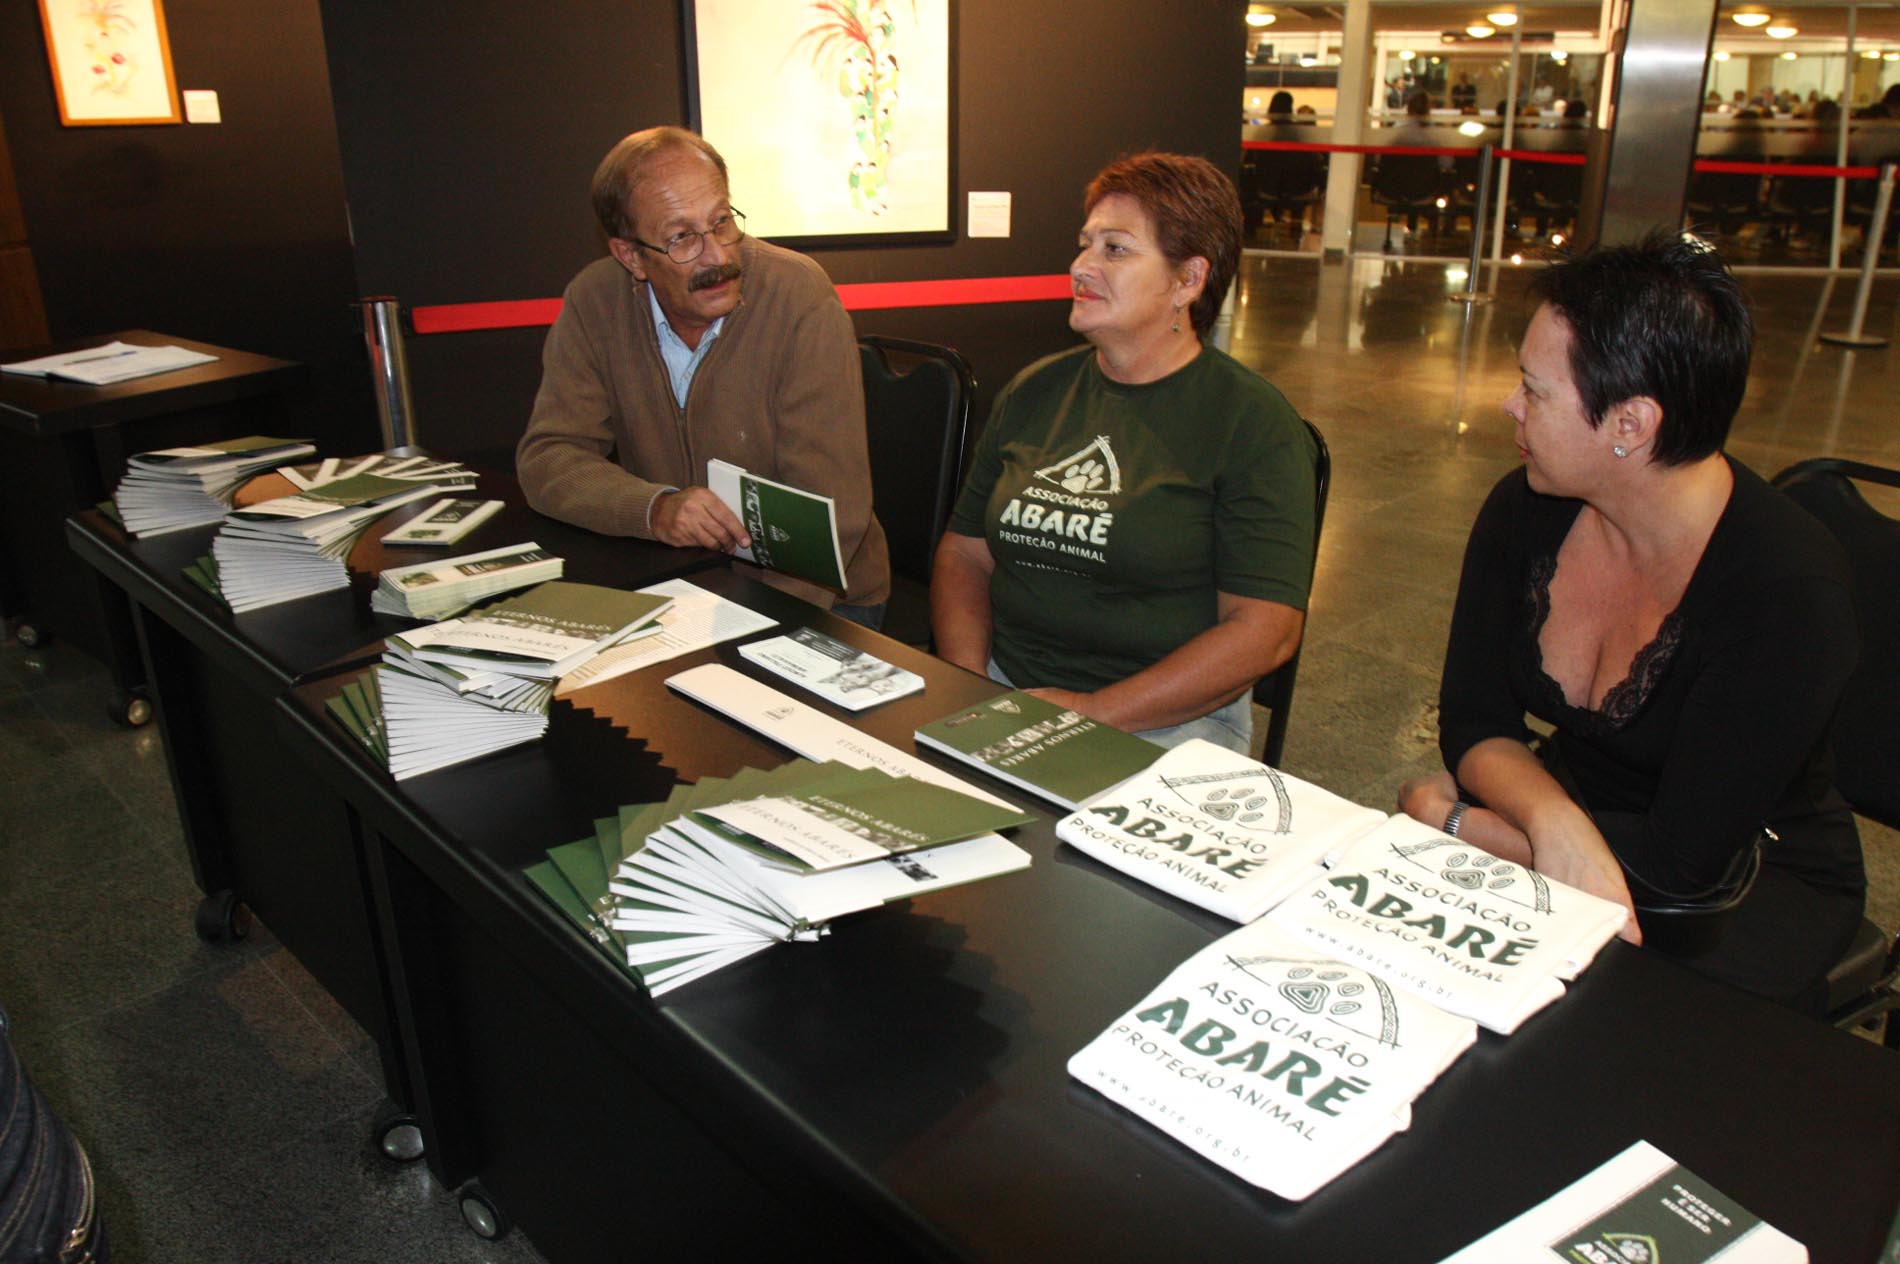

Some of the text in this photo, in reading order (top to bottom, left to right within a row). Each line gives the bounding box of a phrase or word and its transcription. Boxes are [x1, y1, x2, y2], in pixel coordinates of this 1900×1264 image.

[1000, 499, 1114, 546] ABARÉ
[1022, 486, 1109, 511] ASSOCIAÇÃO
[999, 530, 1106, 563] PROTEÇÃO ANIMAL
[1069, 817, 1228, 893] PROTEÇÃO ANIMAL
[1088, 803, 1268, 879] ABARÉ
[1138, 797, 1267, 855] ASSOCIAÇÃO
[1311, 889, 1505, 983] PROTEÇÃO ANIMAL
[1328, 873, 1540, 966] ABARÉ
[1373, 867, 1532, 932] ASSOCIAÇÃO
[1305, 926, 1457, 999] www.abare.org.br
[1135, 997, 1372, 1117] ABARÉ
[1200, 981, 1370, 1067] ASSOCIAÇÃO
[1097, 1069, 1252, 1163] www.abare.org.br
[1111, 1024, 1317, 1142] PROTEÇÃO ANIMAL
[1660, 1198, 1713, 1235] HUMANO
[1672, 1184, 1732, 1227] PROTEGER
